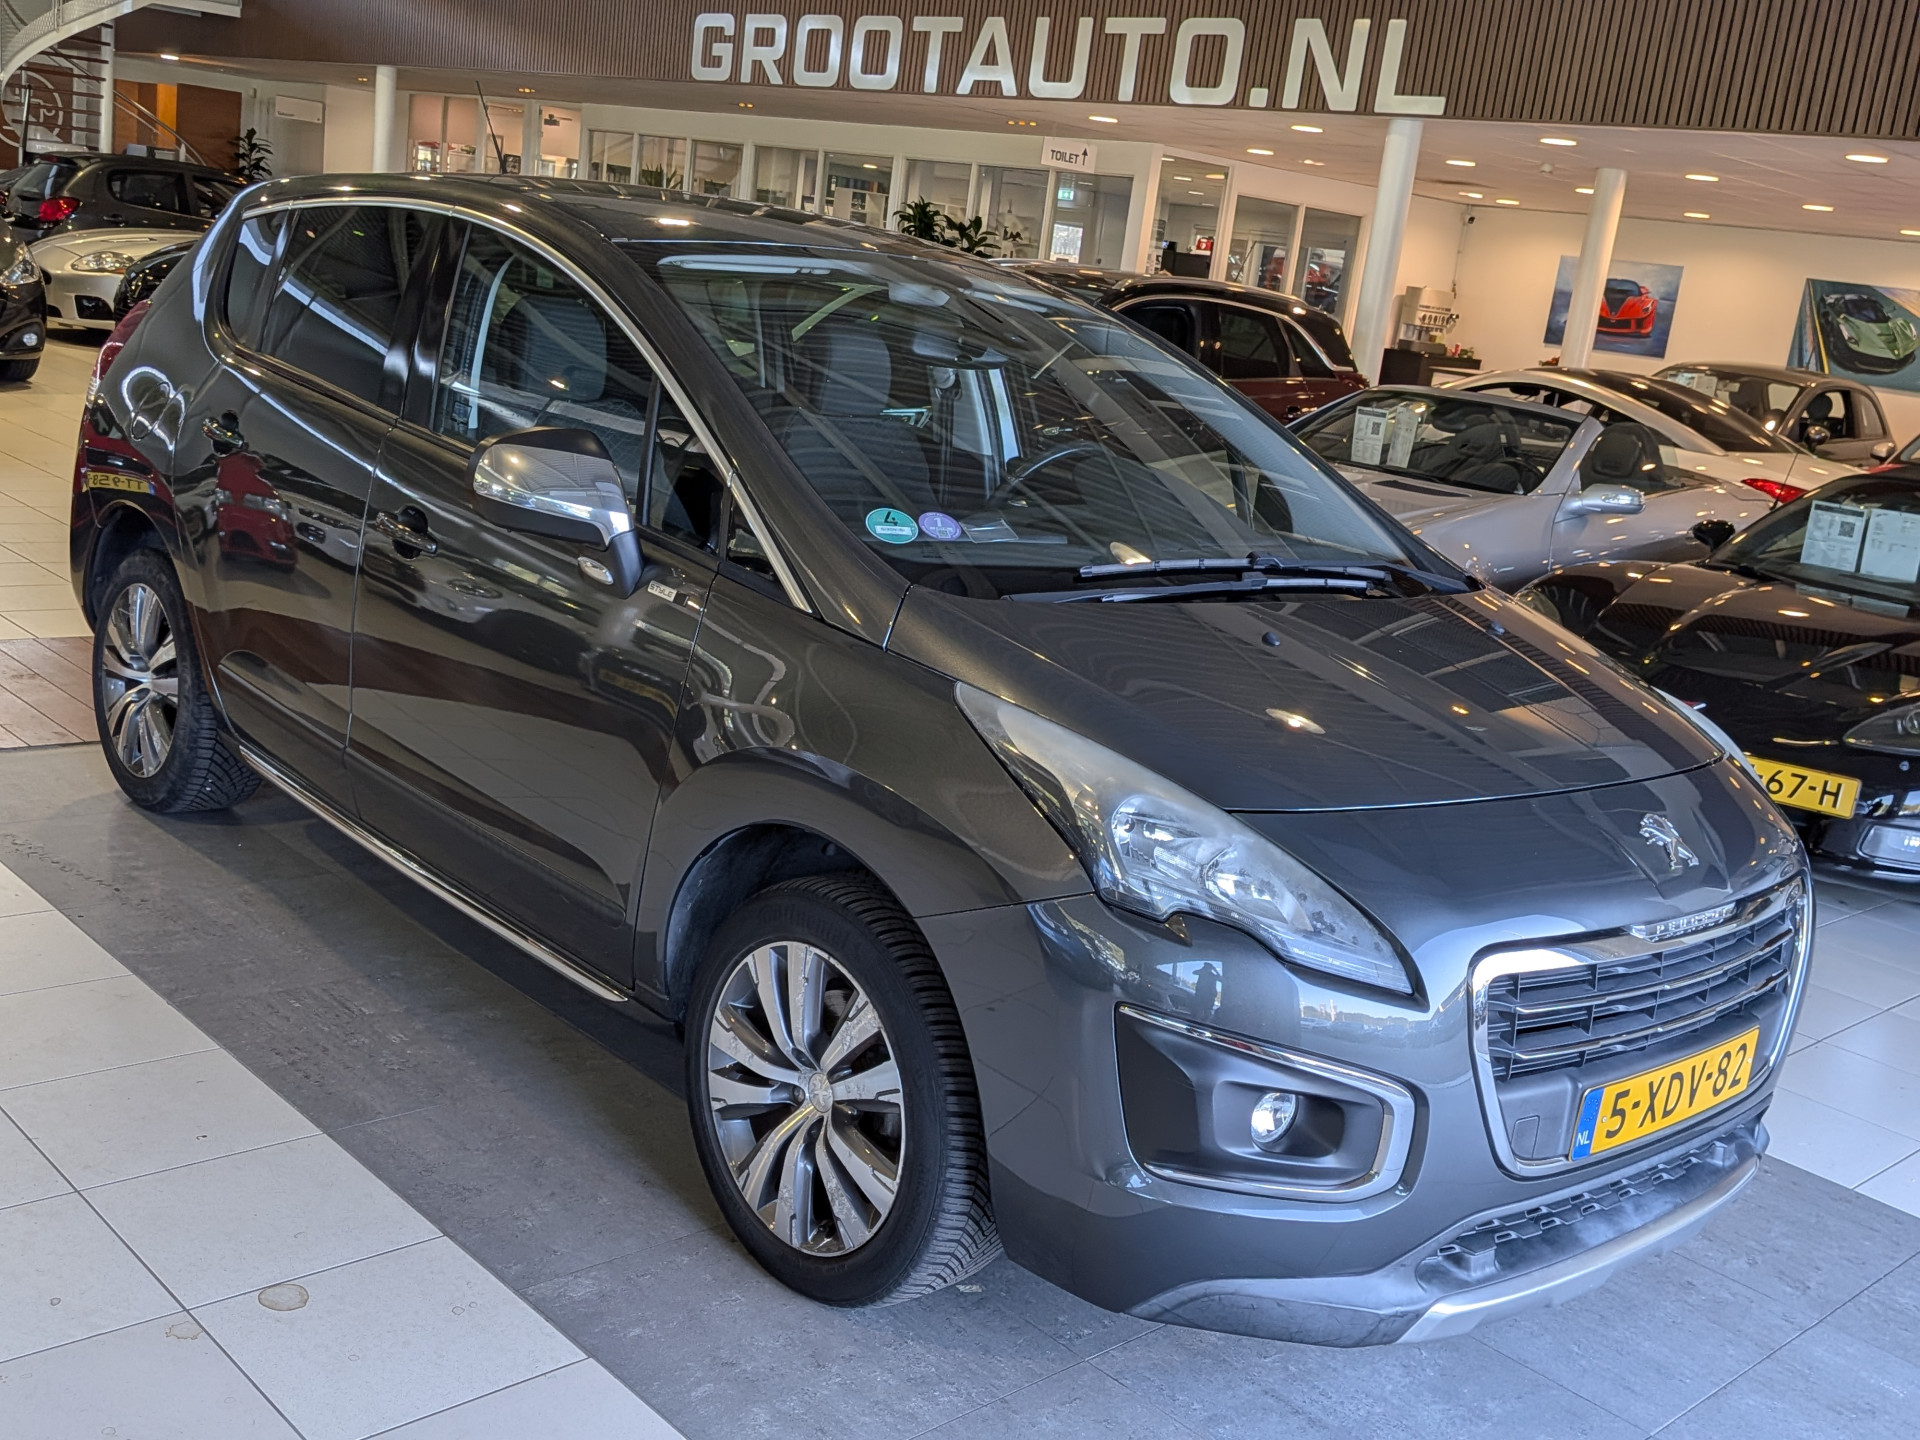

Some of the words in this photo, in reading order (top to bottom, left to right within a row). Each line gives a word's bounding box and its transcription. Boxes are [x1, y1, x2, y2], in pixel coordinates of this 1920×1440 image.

[691, 13, 1446, 115] GROOTAUTO.NL
[1050, 149, 1079, 164] TOILET
[884, 511, 898, 526] 4
[650, 583, 673, 598] STYLE
[1751, 764, 1842, 809] -67-H
[1605, 1043, 1747, 1139] 5-XDV-82
[1576, 1131, 1591, 1147] NL
